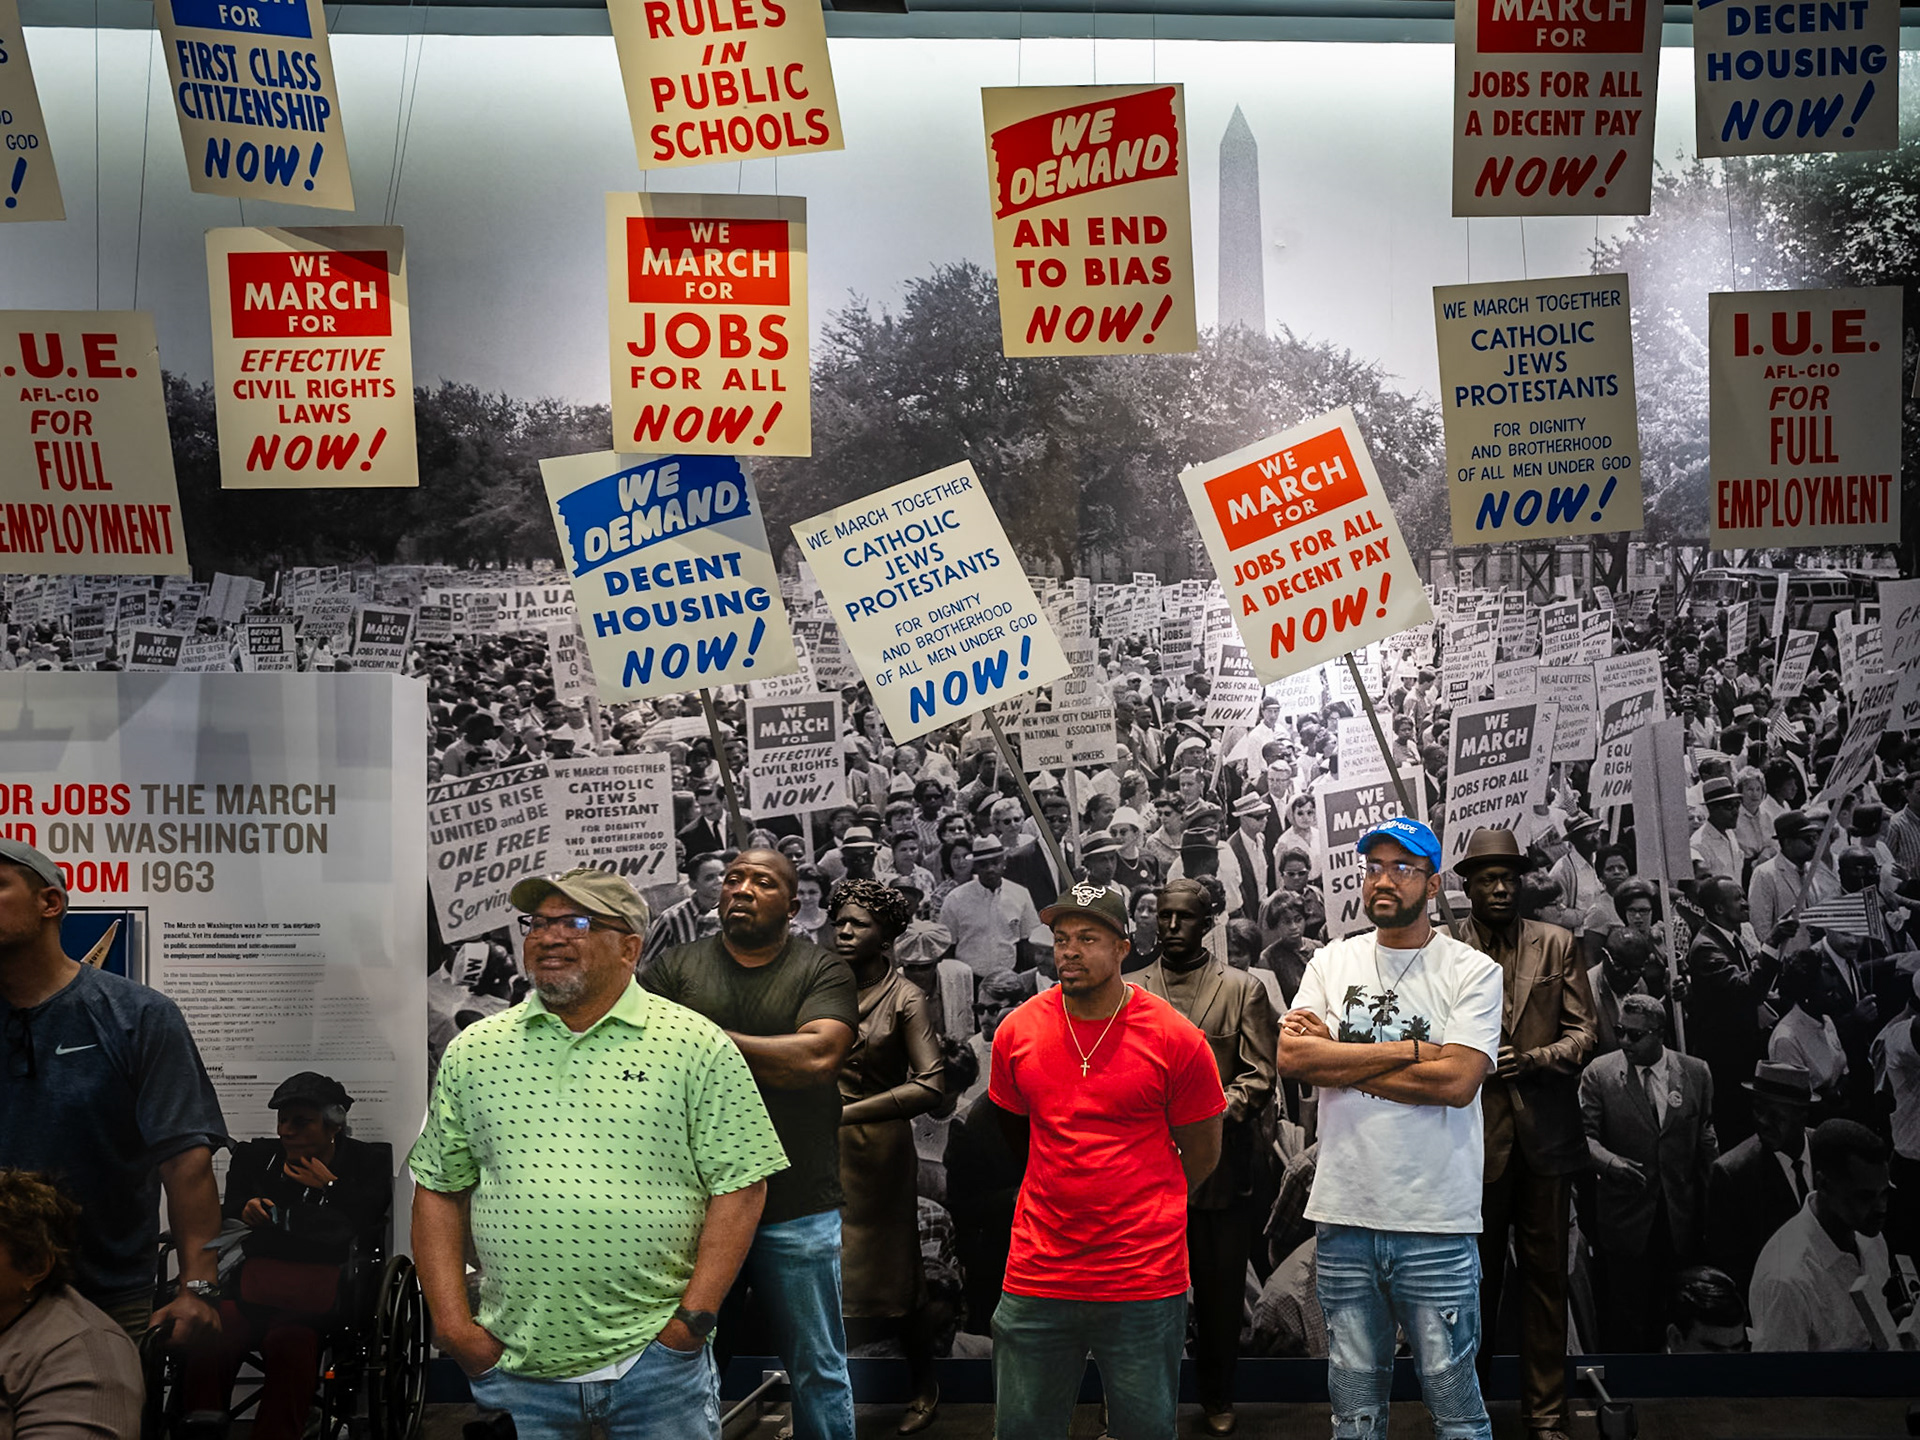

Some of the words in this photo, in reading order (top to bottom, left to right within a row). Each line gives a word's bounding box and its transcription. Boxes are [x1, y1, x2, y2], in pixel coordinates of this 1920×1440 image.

[218, 4, 261, 28] FOR
[643, 0, 786, 39] RULES
[1492, 0, 1631, 22] MARCH
[1727, 1, 1868, 36] DECENT
[701, 40, 747, 66] IN
[1536, 28, 1586, 47] FOR
[175, 39, 239, 83] FIRST
[249, 48, 321, 92] CLASS
[1707, 44, 1887, 81] HOUSING
[650, 62, 809, 113] PUBLIC
[1468, 71, 1530, 98] JOBS
[1540, 71, 1589, 98] FOR
[1600, 71, 1642, 98] ALL
[178, 81, 330, 133] CITIZENSHIP
[1465, 110, 1482, 136] A
[1493, 110, 1585, 136] DECENT
[1595, 110, 1642, 136] PAY
[1721, 79, 1875, 142] NOW!
[6, 134, 39, 150] GOD
[650, 108, 830, 161] SCHOOLS
[1052, 107, 1115, 155] WE
[204, 137, 324, 191] NOW!
[1011, 134, 1169, 205] DEMAND
[1475, 149, 1627, 198] NOW!
[689, 222, 730, 244] WE
[1013, 218, 1070, 247] AN
[1088, 216, 1167, 245] END
[289, 255, 331, 277] WE
[641, 247, 776, 279] MARCH
[1016, 258, 1067, 288] TO
[1084, 256, 1172, 286] BIAS
[243, 281, 378, 310] MARCH
[685, 281, 734, 300] FOR
[1443, 302, 1467, 320] WE
[1474, 298, 1529, 317] MARCH
[1536, 289, 1620, 312] TOGETHER
[288, 315, 337, 333] FOR
[1026, 294, 1172, 344] NOW!
[1734, 309, 1880, 356] I.U.E.
[627, 312, 789, 360] JOBS
[1471, 321, 1595, 351] CATHOLIC
[0, 332, 138, 379] .U.E.
[240, 348, 386, 372] EFFECTIVE
[1503, 351, 1567, 376] JEWS
[1764, 363, 1840, 379] AFL-CIO
[233, 379, 296, 400] CIVIL
[306, 378, 396, 398] RIGHTS
[631, 366, 702, 390] FOR
[722, 368, 786, 392] ALL
[1456, 374, 1618, 407] PROTESTANTS
[20, 388, 99, 403] AFL-CIO
[1769, 385, 1829, 411] FOR
[30, 410, 92, 436] FOR
[278, 403, 351, 424] LAWS
[633, 401, 782, 446] NOW!
[1494, 422, 1520, 437] FOR
[1530, 417, 1586, 435] DIGNITY
[246, 427, 388, 472] NOW!
[1471, 445, 1501, 460] AND
[1509, 436, 1612, 456] BROTHERHOOD
[1770, 415, 1839, 465] FULL
[34, 441, 113, 491] FULL
[1258, 451, 1298, 479] WE
[1458, 467, 1476, 482] OF
[1481, 466, 1504, 481] ALL
[1513, 463, 1542, 478] MEN
[1548, 459, 1595, 475] UNDER
[1602, 456, 1631, 470] GOD
[618, 462, 680, 512] WE
[1227, 455, 1347, 525] MARCH
[1476, 476, 1617, 530] NOW!
[1718, 474, 1892, 529] EMPLOYMENT
[584, 481, 739, 562] DEMAND
[806, 530, 832, 550] WE
[834, 507, 889, 540] MARCH
[892, 476, 973, 516] TOGETHER
[1273, 499, 1318, 527] FOR
[843, 510, 960, 567] CATHOLIC
[1233, 549, 1286, 587] JOBS
[1290, 529, 1337, 562] FOR
[1343, 510, 1383, 541] ALL
[604, 552, 742, 597] DECENT
[885, 542, 945, 581] JEWS
[1241, 594, 1259, 616] A
[1262, 558, 1343, 607] DECENT
[1349, 536, 1391, 571] PAY
[845, 548, 1000, 622] PROTESTANTS
[381, 614, 396, 624] WE
[593, 586, 770, 638] HOUSING
[895, 618, 922, 637] FOR
[928, 593, 981, 623] DIGNITY
[1270, 572, 1391, 659] NOW!
[364, 623, 405, 637] MARCH
[882, 643, 911, 663] AND
[916, 602, 1012, 649] BROTHERHOOD
[622, 616, 765, 688] NOW!
[876, 669, 894, 686] OF
[898, 660, 922, 679] ALL
[927, 646, 956, 665] MEN
[962, 627, 1005, 652] UNDER
[1009, 613, 1038, 633] GOD
[910, 635, 1031, 724] NOW!
[759, 717, 829, 738] MARCH
[781, 706, 807, 719] WE
[1022, 717, 1038, 727] NEW
[1040, 715, 1060, 725] YORK
[1062, 713, 1078, 723] CITY
[1081, 709, 1112, 721] CHAPTER
[1484, 712, 1509, 731] WE
[781, 735, 809, 744] FOR
[1024, 729, 1059, 741] NATIONAL
[1066, 723, 1112, 736] ASSOCIATION
[1065, 740, 1074, 749] OF
[1460, 727, 1528, 759] MARCH
[752, 761, 788, 777] CIVIL
[790, 758, 839, 773] RIGHTS
[762, 747, 833, 764] EFFECTIVE
[1038, 755, 1064, 766] SOCIAL
[1072, 750, 1105, 762] WORKERS
[1479, 751, 1507, 766] FOR
[477, 764, 544, 792] SAYS:
[568, 778, 654, 794] CATHOLIC
[776, 773, 816, 787] LAWS
[1451, 779, 1479, 801] JOBS
[1482, 774, 1506, 792] FOR
[1509, 768, 1529, 786] ALL
[42, 784, 131, 815] JOBS
[140, 784, 206, 815] THE
[215, 784, 336, 815] MARCH
[430, 804, 463, 826] LET
[467, 799, 493, 817] US
[500, 785, 544, 808] RISE
[585, 792, 637, 806] JEWS
[762, 781, 835, 810] NOW!
[1448, 811, 1458, 824] A
[1459, 797, 1502, 819] DECENT
[1505, 790, 1529, 808] PAY
[430, 817, 498, 845] UNITED
[500, 809, 525, 829] and
[528, 803, 549, 820] BE
[565, 804, 659, 820] PROTESTANT
[48, 822, 94, 854] ON
[104, 822, 328, 854] WASHINGTON
[438, 841, 488, 870] ONE
[496, 825, 551, 856] FREE
[141, 861, 215, 893] 1963
[454, 850, 547, 892] PEOPLE
[206, 922, 243, 931] Washington
